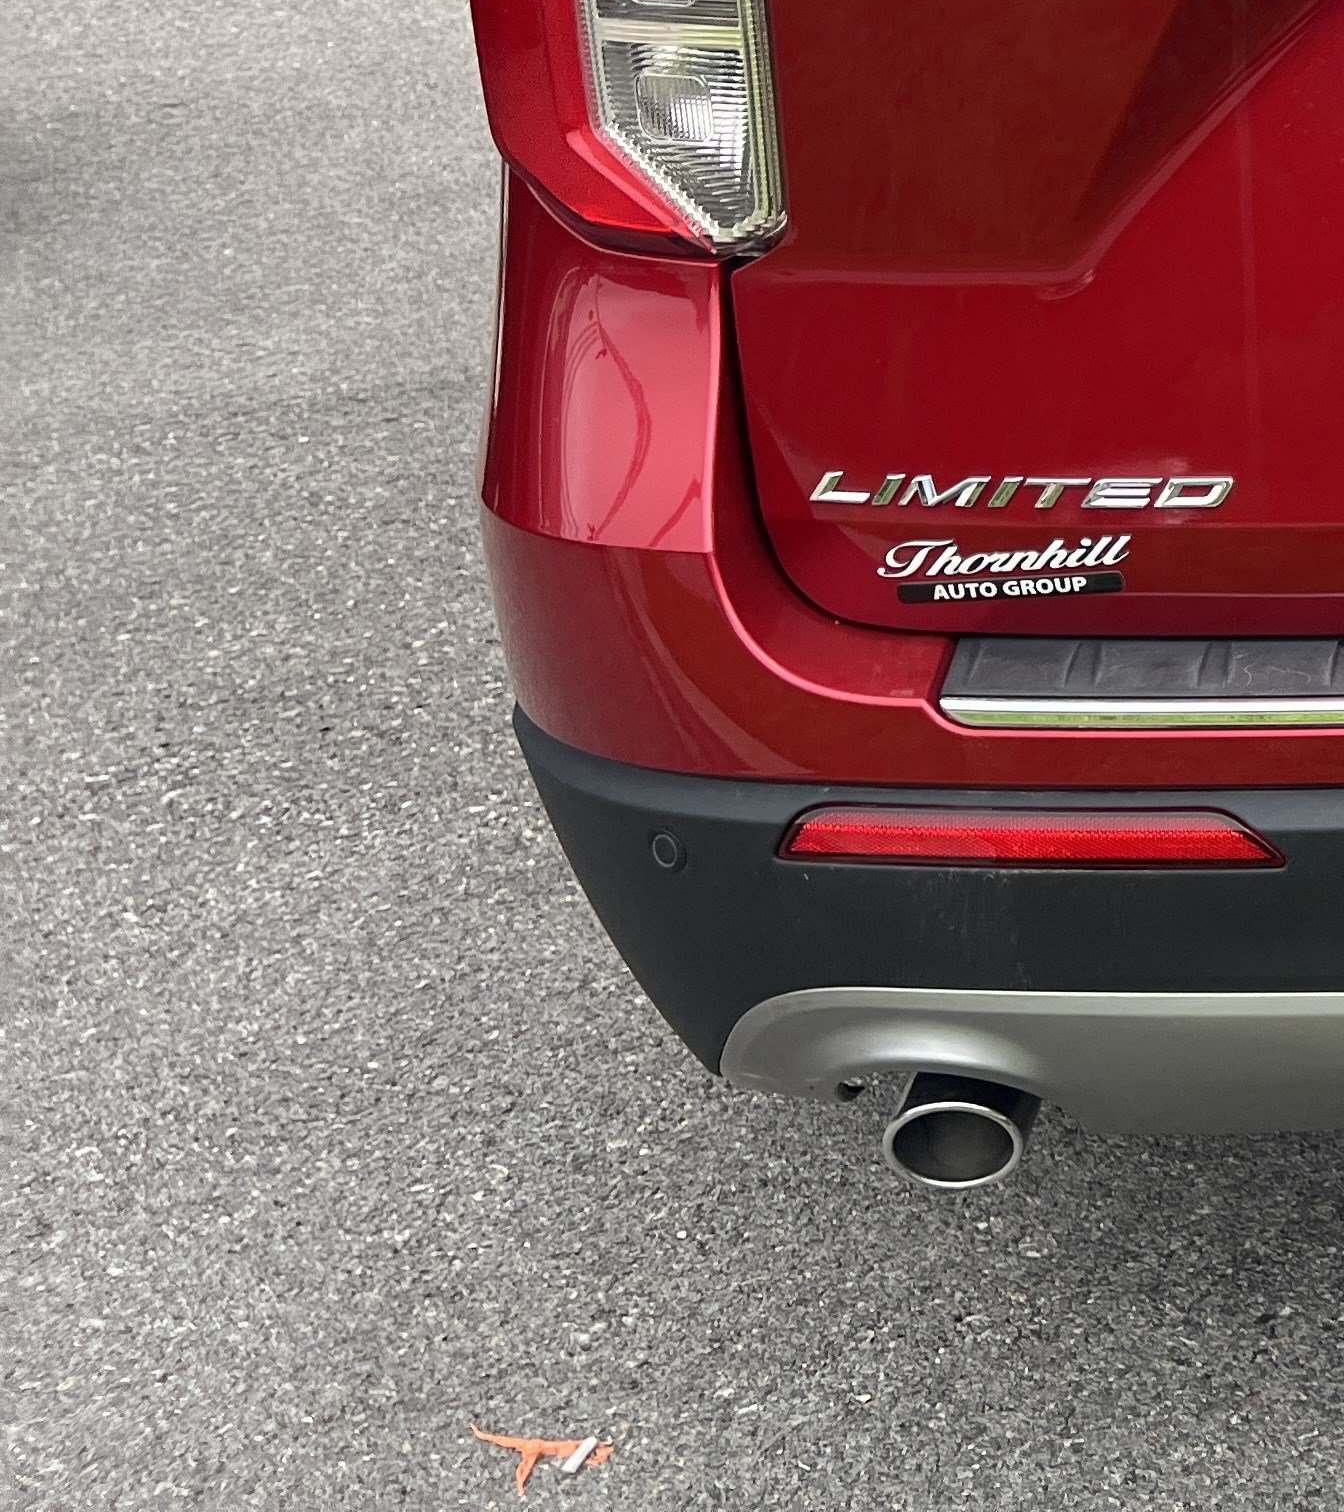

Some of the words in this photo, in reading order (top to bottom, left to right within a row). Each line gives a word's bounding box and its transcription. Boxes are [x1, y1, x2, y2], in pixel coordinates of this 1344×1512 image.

[809, 470, 1236, 509] LIMITED
[876, 533, 1132, 578] Thornhill
[933, 582, 998, 601] AUTO
[1002, 576, 1087, 597] GROUP
